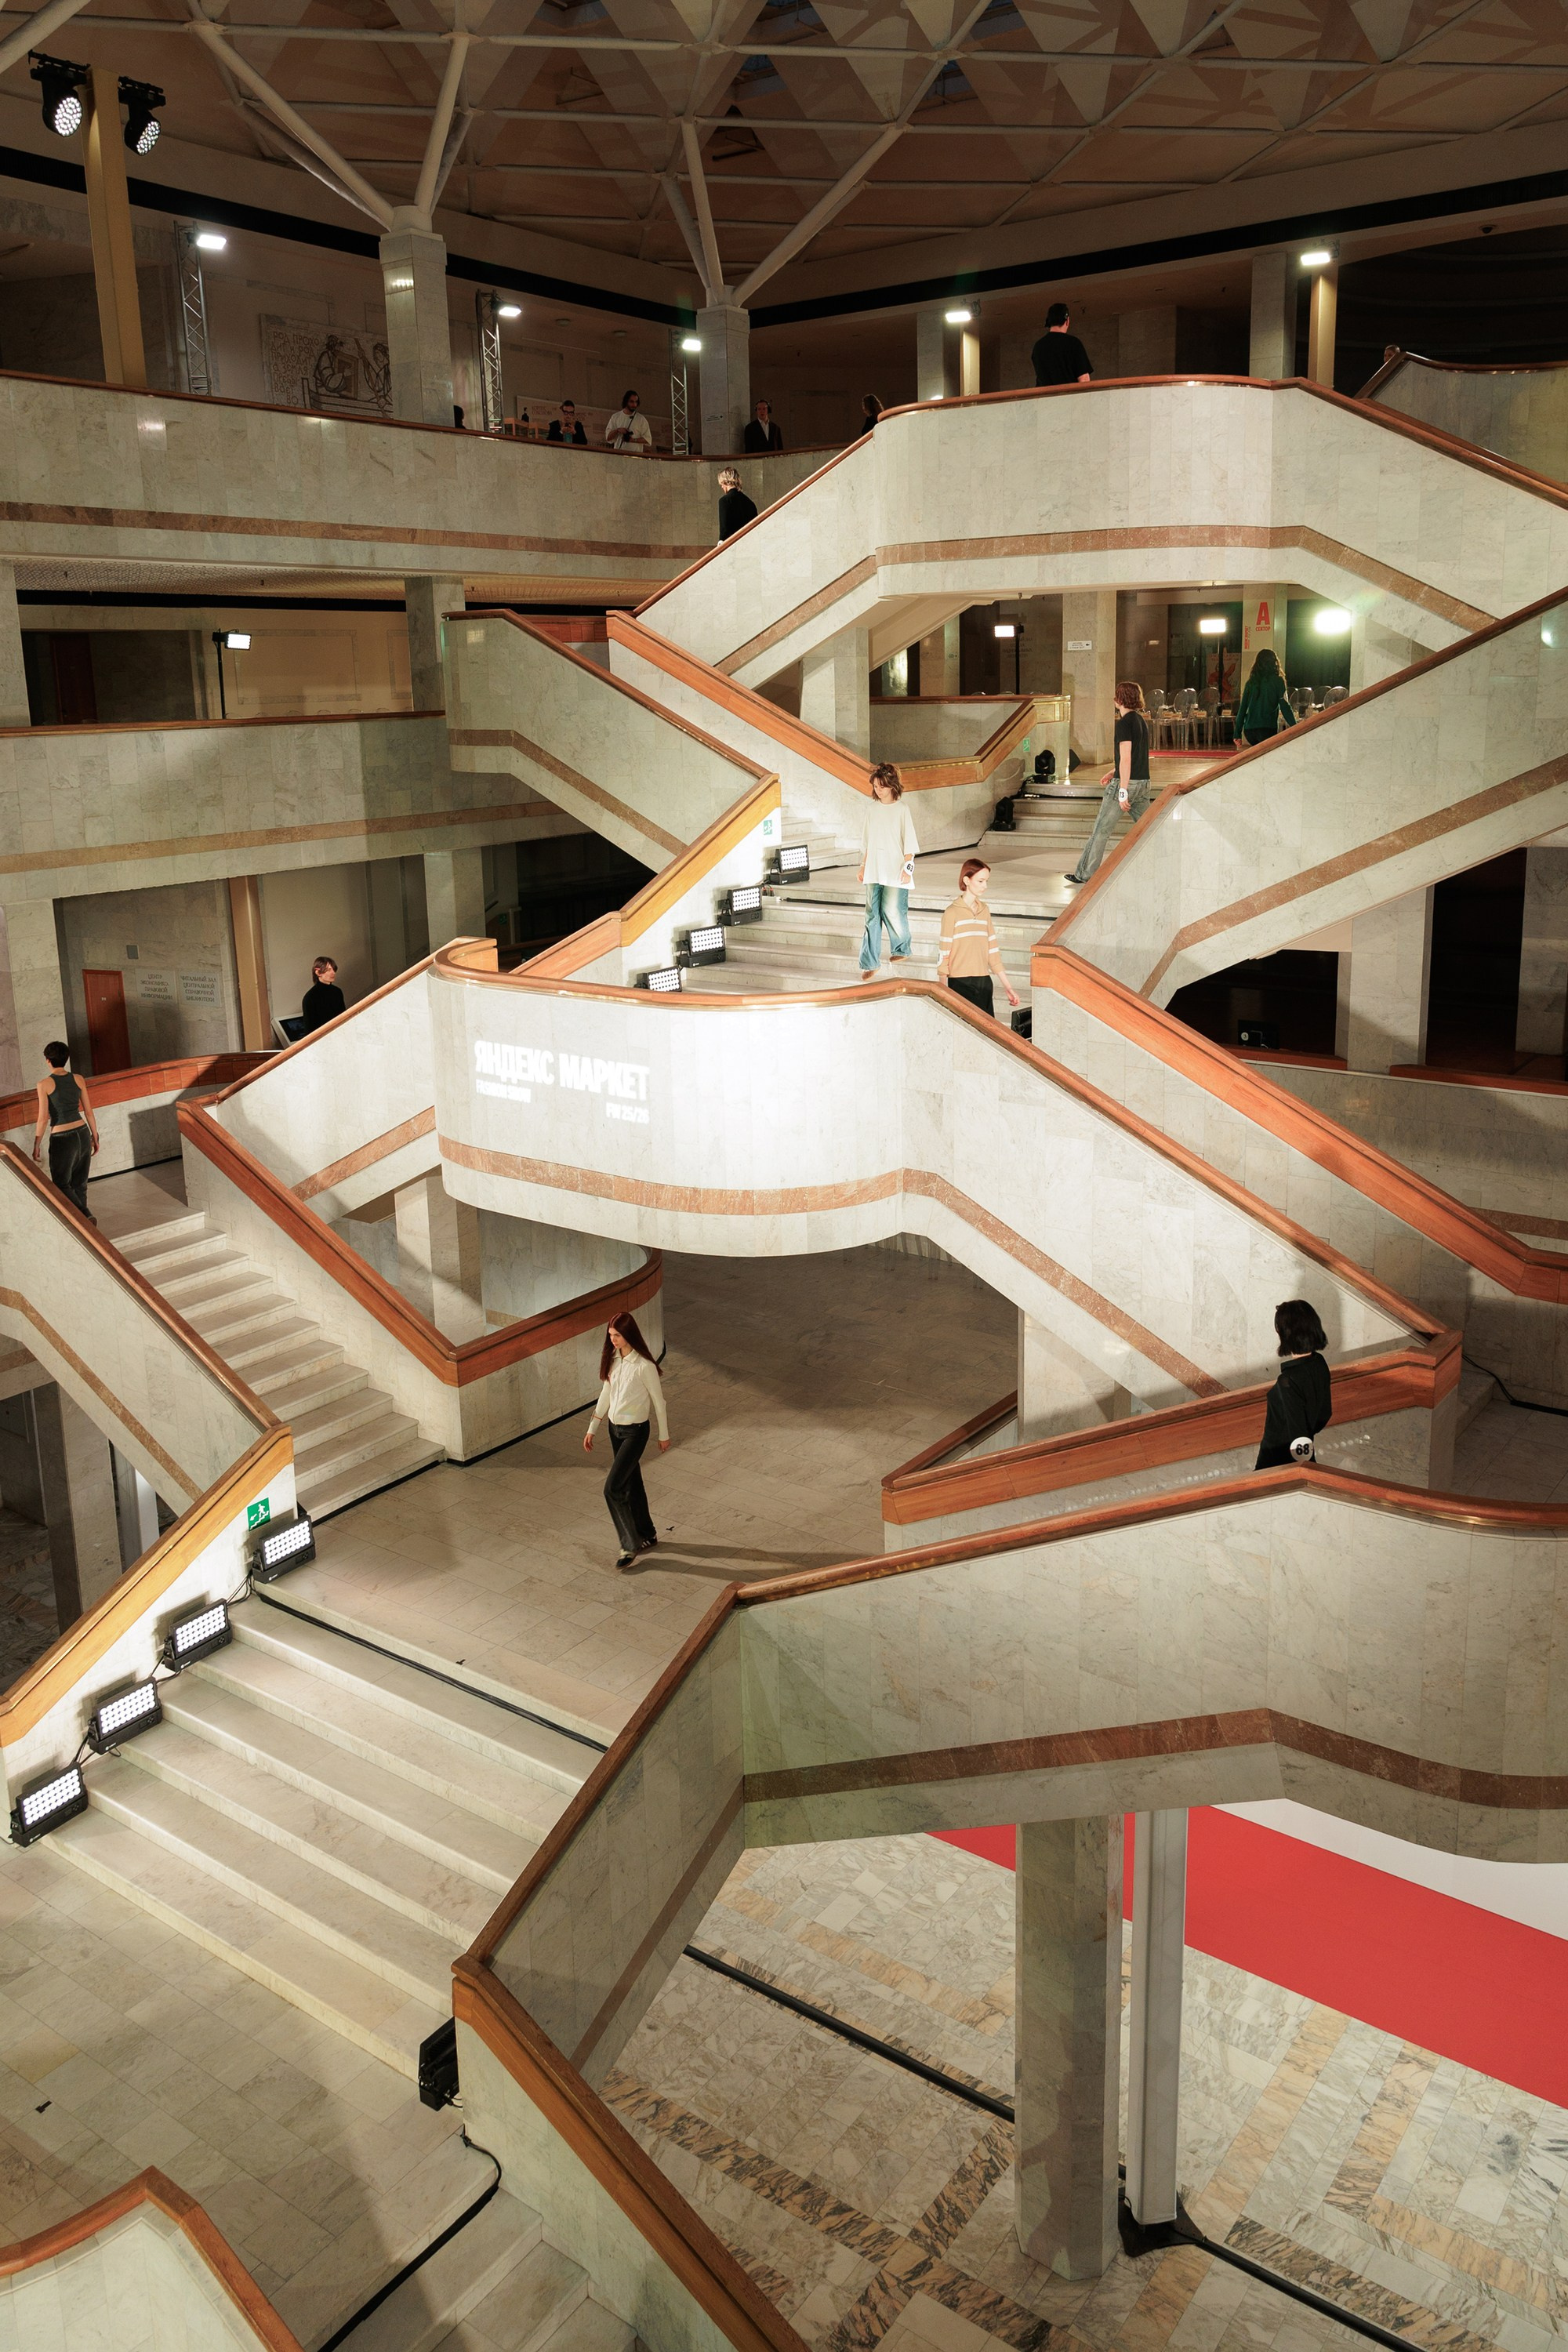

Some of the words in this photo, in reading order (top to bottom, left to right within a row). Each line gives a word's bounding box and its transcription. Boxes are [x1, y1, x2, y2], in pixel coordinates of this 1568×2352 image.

[1256, 601, 1270, 625] А
[474, 1040, 555, 1086] ЯНДЕКС
[558, 1053, 650, 1102] МАРКЕТ
[1296, 1443, 1309, 1456] 68
